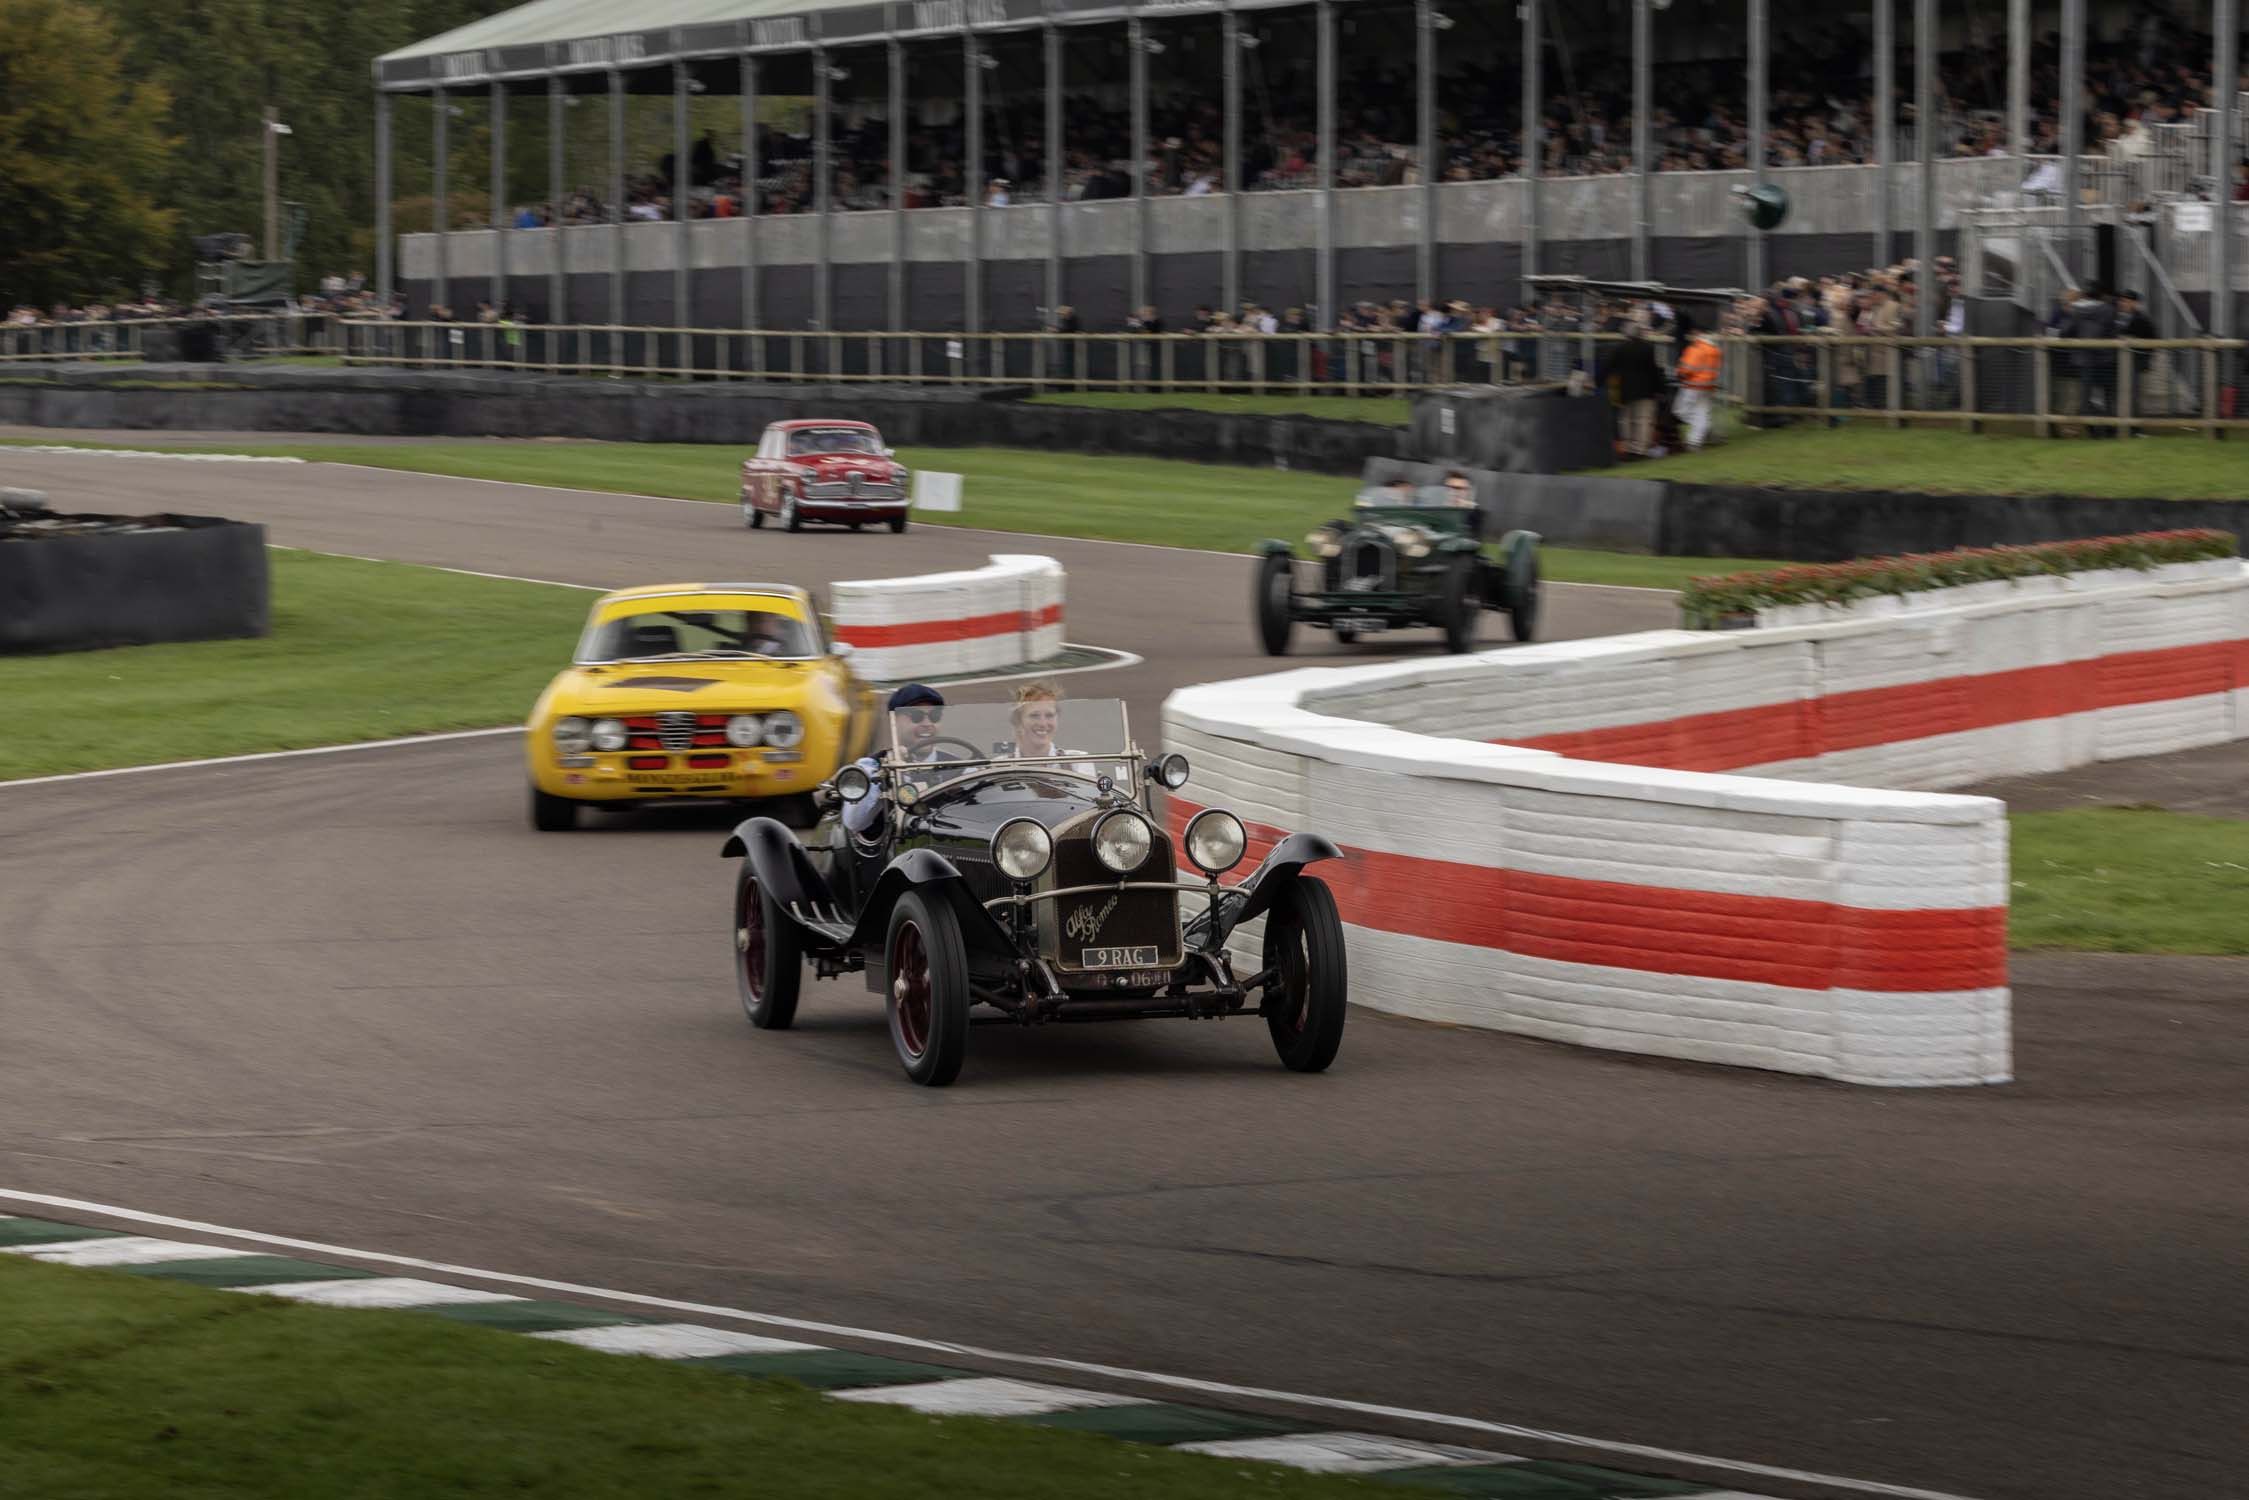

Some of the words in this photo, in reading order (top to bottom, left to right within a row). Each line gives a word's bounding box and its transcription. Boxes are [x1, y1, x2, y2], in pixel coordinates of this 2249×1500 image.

[1066, 904, 1093, 941] Alfa
[1084, 895, 1118, 943] Romeo
[1097, 950, 1107, 967] 9
[1111, 948, 1144, 967] RAG
